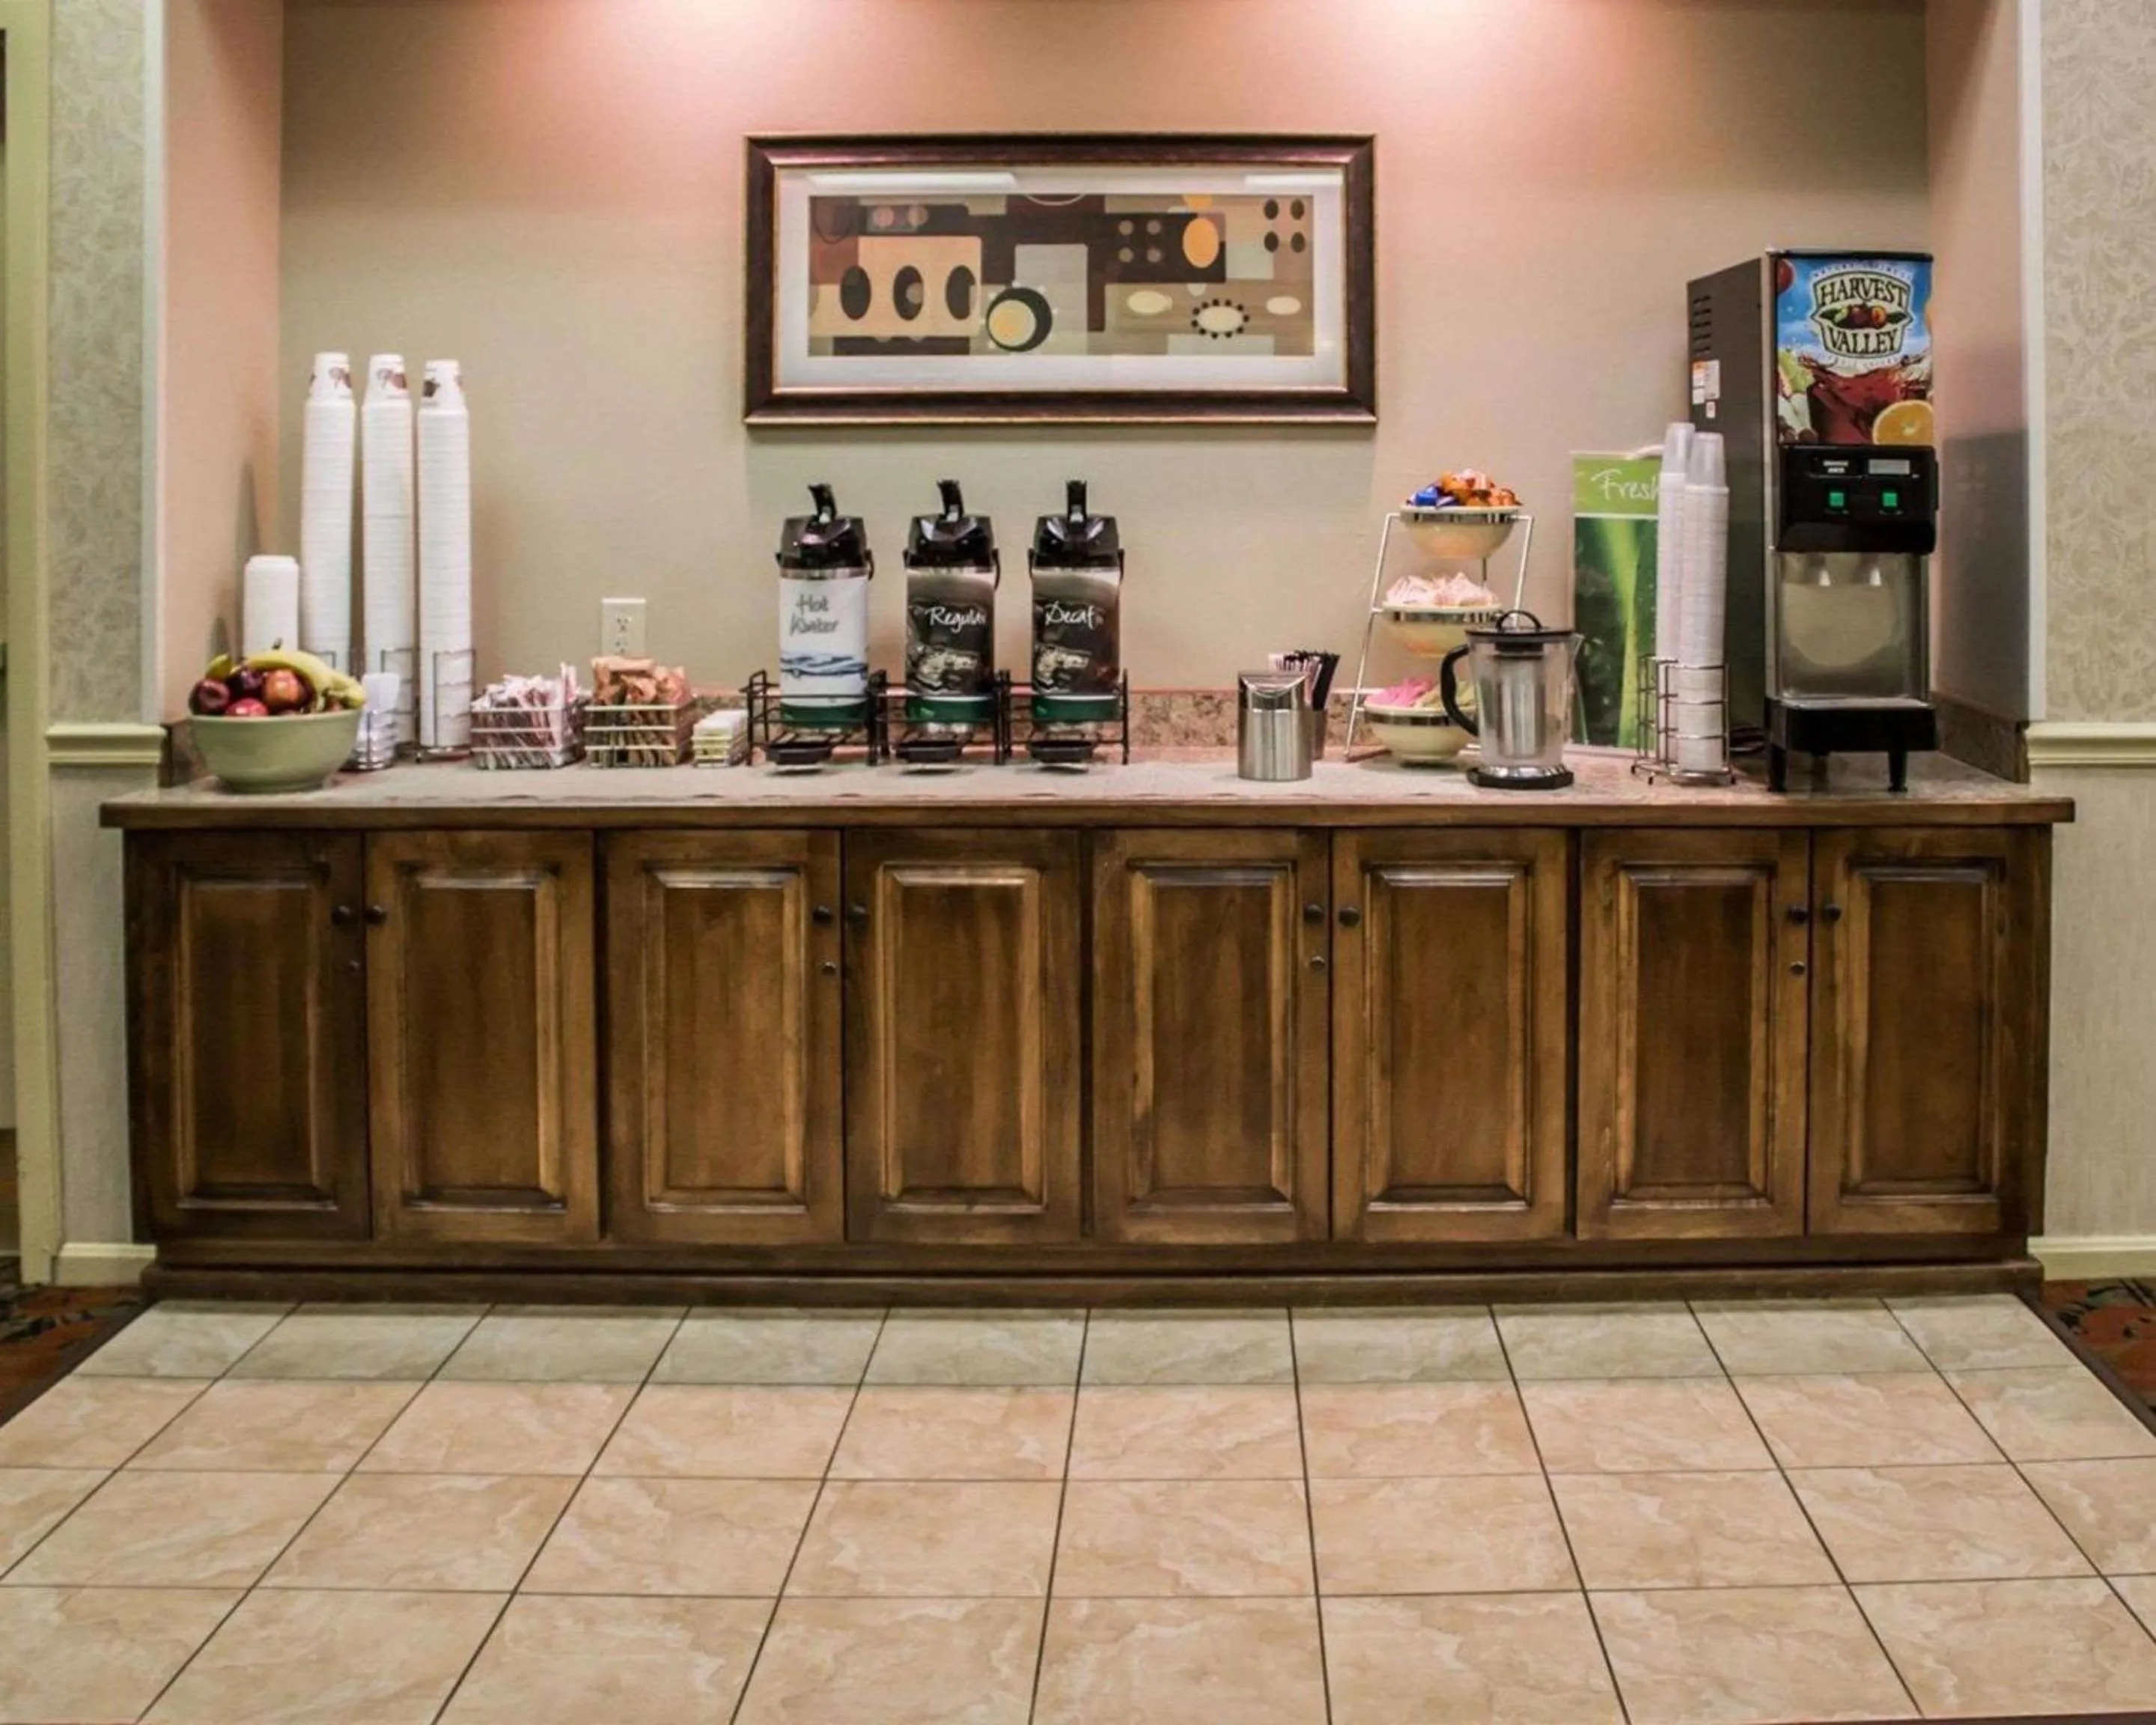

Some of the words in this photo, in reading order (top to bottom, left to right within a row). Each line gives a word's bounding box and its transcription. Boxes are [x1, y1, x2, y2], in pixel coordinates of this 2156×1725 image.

[1818, 276, 1908, 306] HARVEST
[1827, 326, 1899, 355] VALLEY
[794, 594, 829, 615] Hot
[1044, 600, 1095, 630] Decaf
[789, 612, 839, 636] Water
